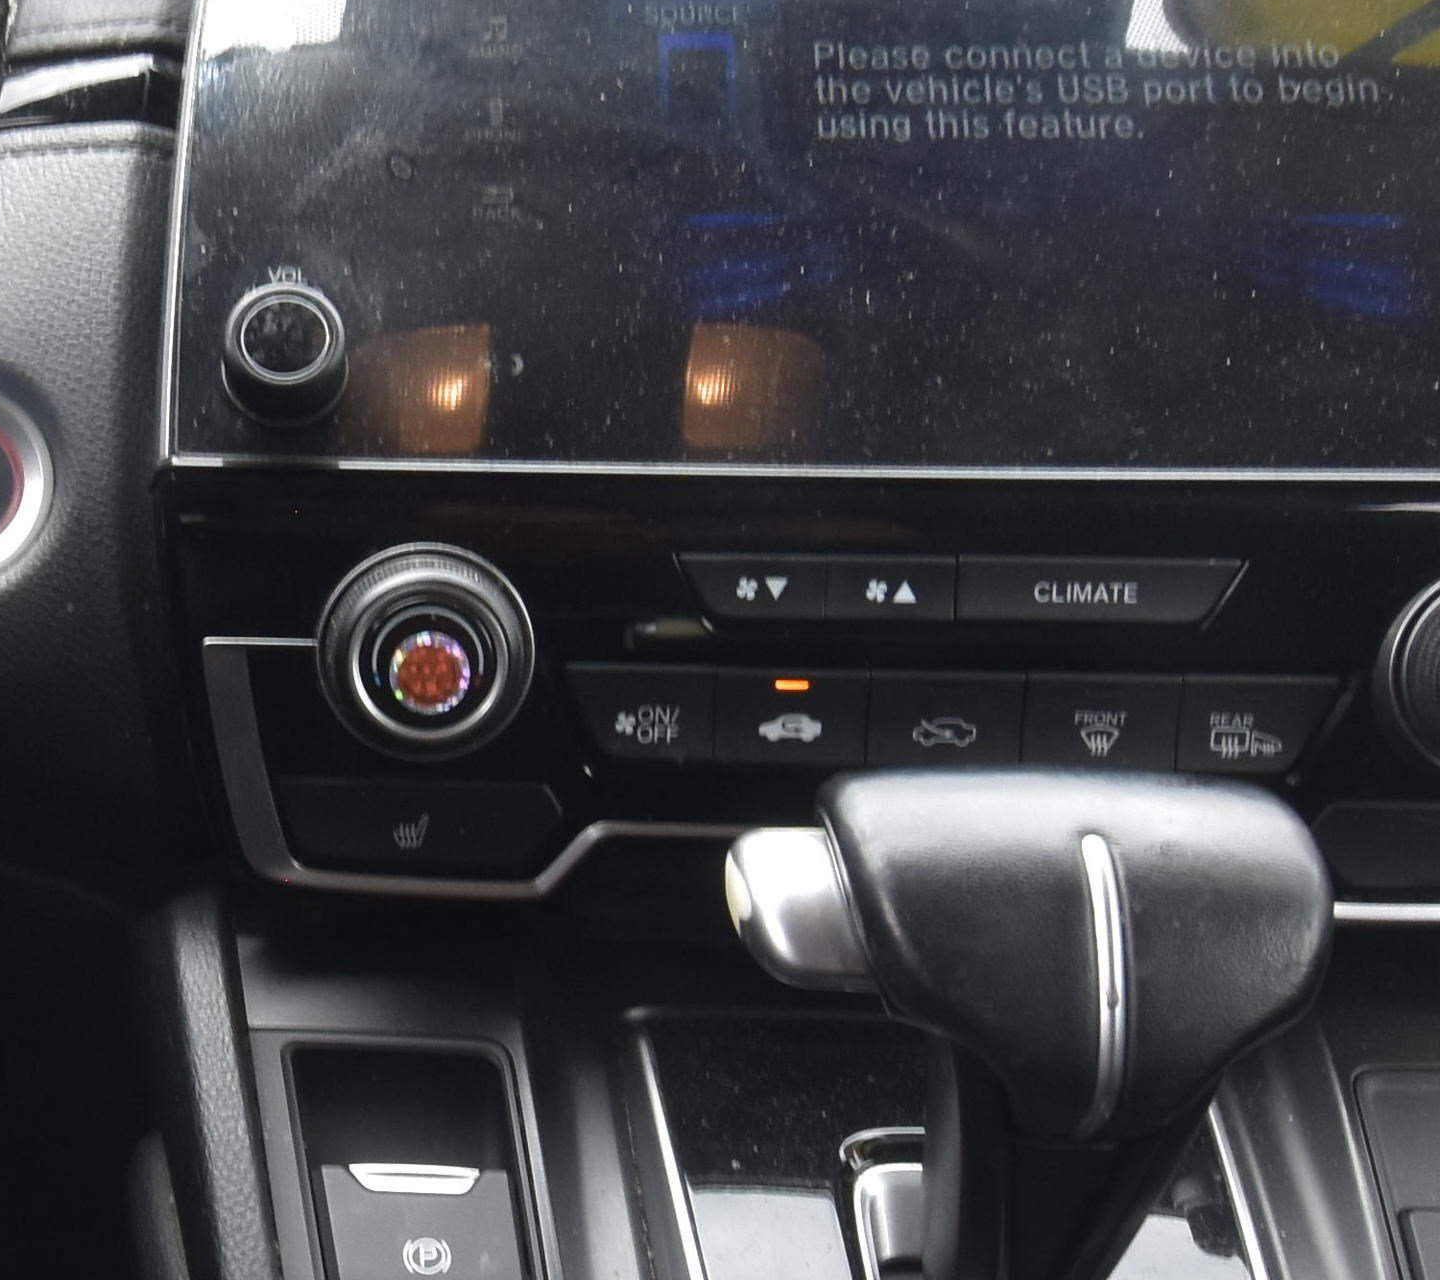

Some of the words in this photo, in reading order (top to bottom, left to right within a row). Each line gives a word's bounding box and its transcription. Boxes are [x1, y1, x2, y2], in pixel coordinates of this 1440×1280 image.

[813, 39, 931, 70] Please
[944, 39, 1091, 70] connect
[1104, 46, 1123, 70] a
[1270, 39, 1340, 70] into
[813, 74, 871, 105] the
[886, 73, 1043, 105] vehicle's
[1056, 74, 1129, 104] USB
[1143, 75, 1216, 112] port
[1229, 75, 1265, 104] to
[1278, 74, 1379, 111] begin
[816, 110, 911, 142] using
[924, 110, 989, 141] this
[1001, 110, 1145, 141] feature.
[1033, 580, 1140, 605] CLIMATE
[1074, 710, 1129, 728] FRONT
[1208, 711, 1256, 729] REAR
[636, 726, 681, 746] OFF
